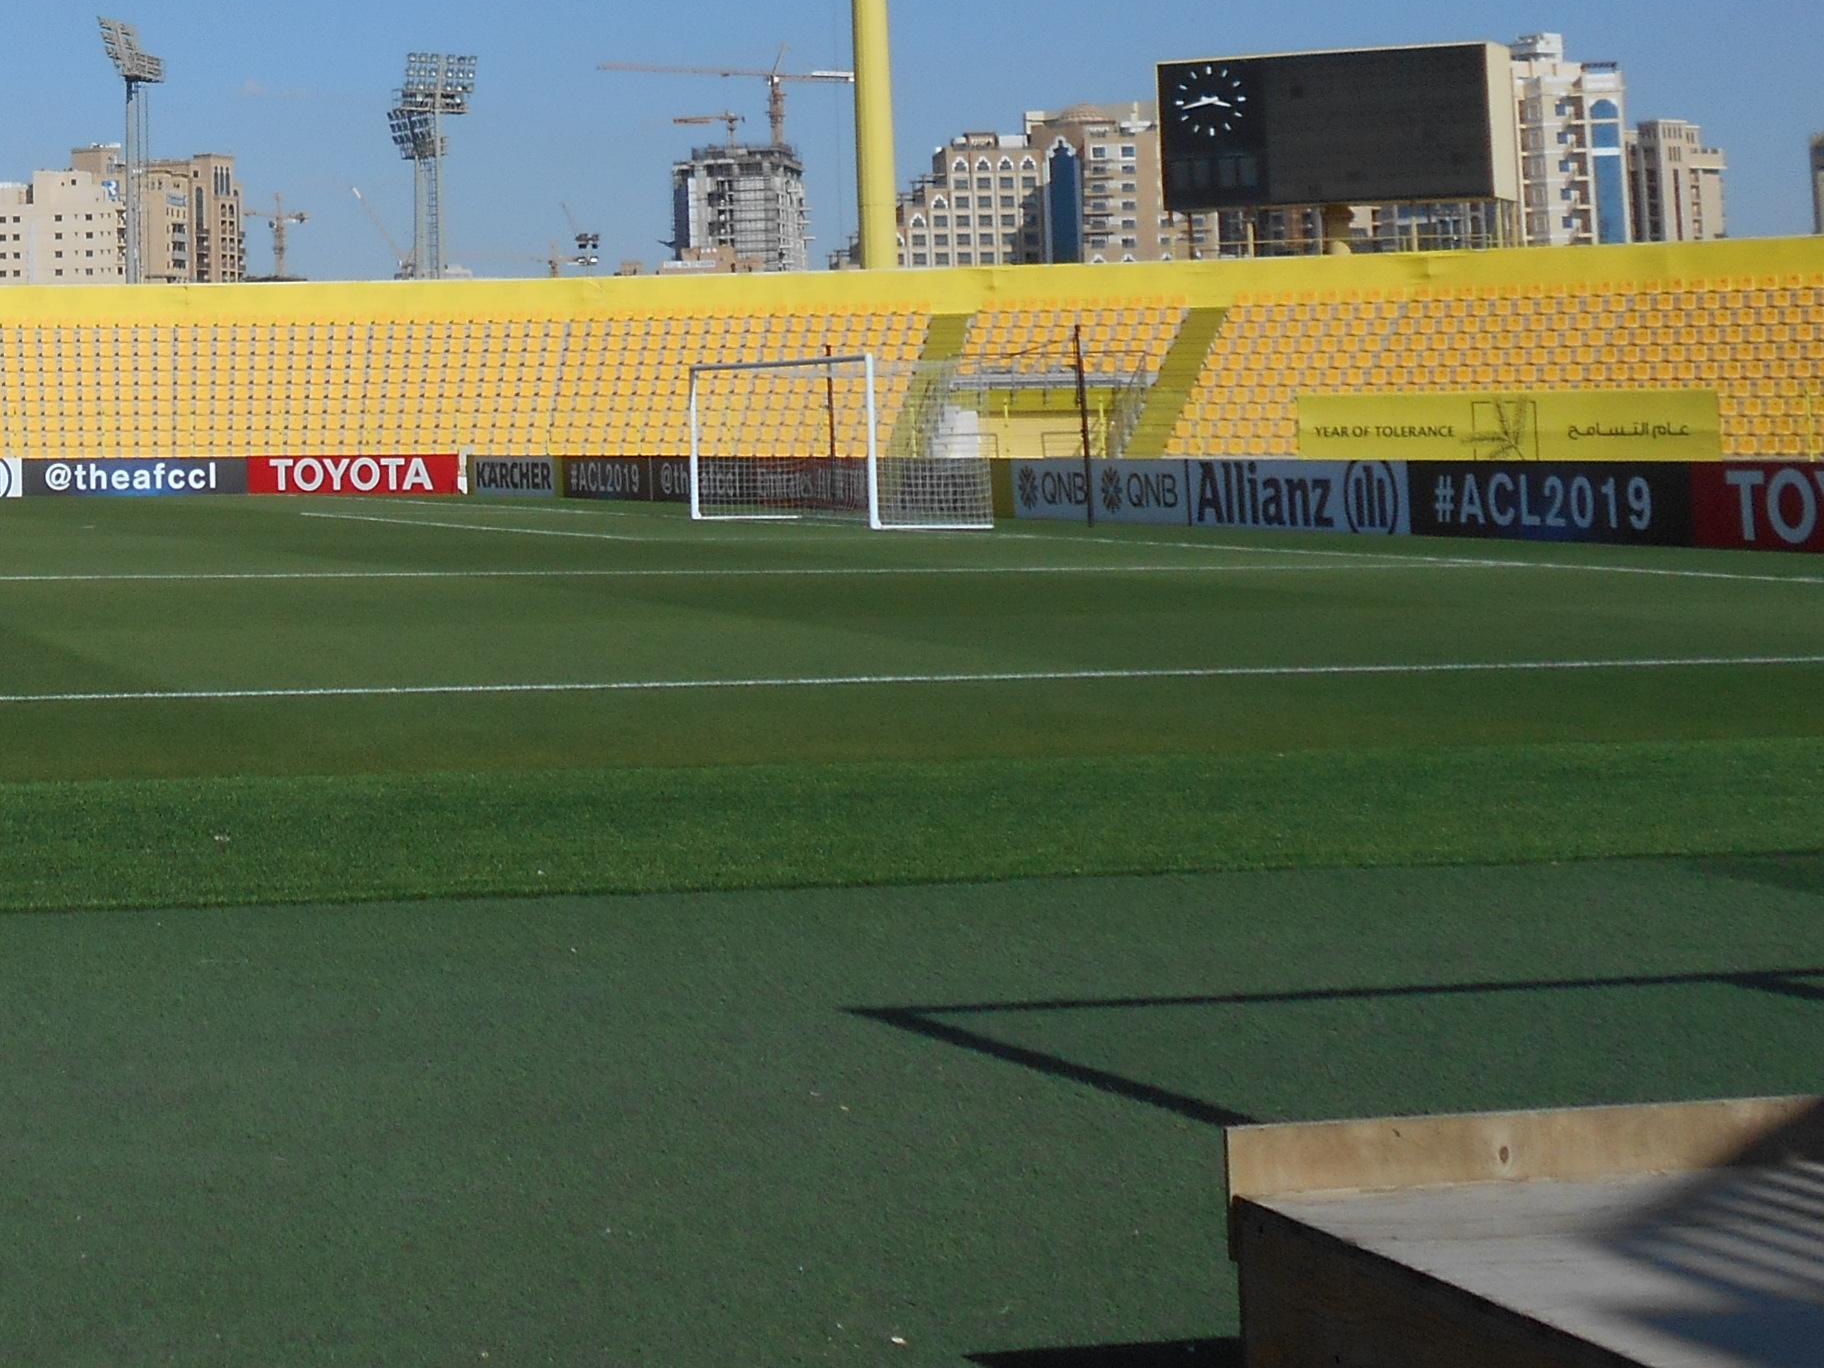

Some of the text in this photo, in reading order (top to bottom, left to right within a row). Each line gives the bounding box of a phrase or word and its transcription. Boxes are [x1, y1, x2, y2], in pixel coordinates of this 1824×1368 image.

[1314, 424, 1455, 438] YEAR OF TOLERANCE
[1567, 421, 1689, 440] عام التسامح
[44, 461, 217, 492] @theafccl
[269, 457, 434, 492] TOYOTA
[570, 463, 640, 493] #ACL2019
[660, 462, 739, 498] @thafccl
[1041, 471, 1089, 505] QNB
[1127, 472, 1178, 508] QNB
[1196, 462, 1334, 528] Allianz
[1434, 472, 1653, 531] #ACL2019
[1724, 467, 1824, 544] TO
